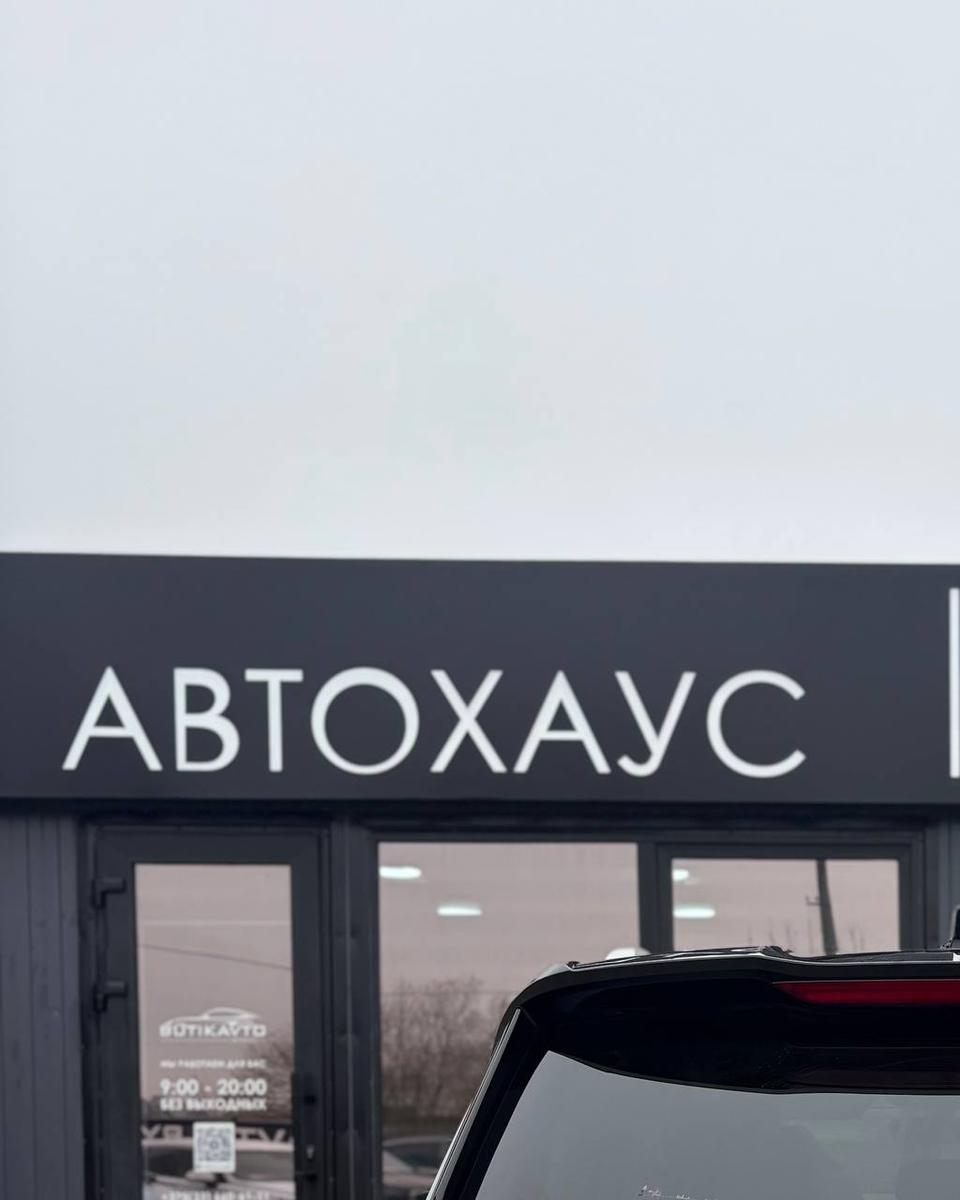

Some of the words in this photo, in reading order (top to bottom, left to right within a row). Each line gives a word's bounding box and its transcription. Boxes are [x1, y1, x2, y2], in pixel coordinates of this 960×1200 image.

[62, 665, 807, 778] АВТОХАУС
[159, 1023, 267, 1038] BUTIKAVTO
[160, 1078, 199, 1097] 9:00
[217, 1077, 268, 1097] 20:00
